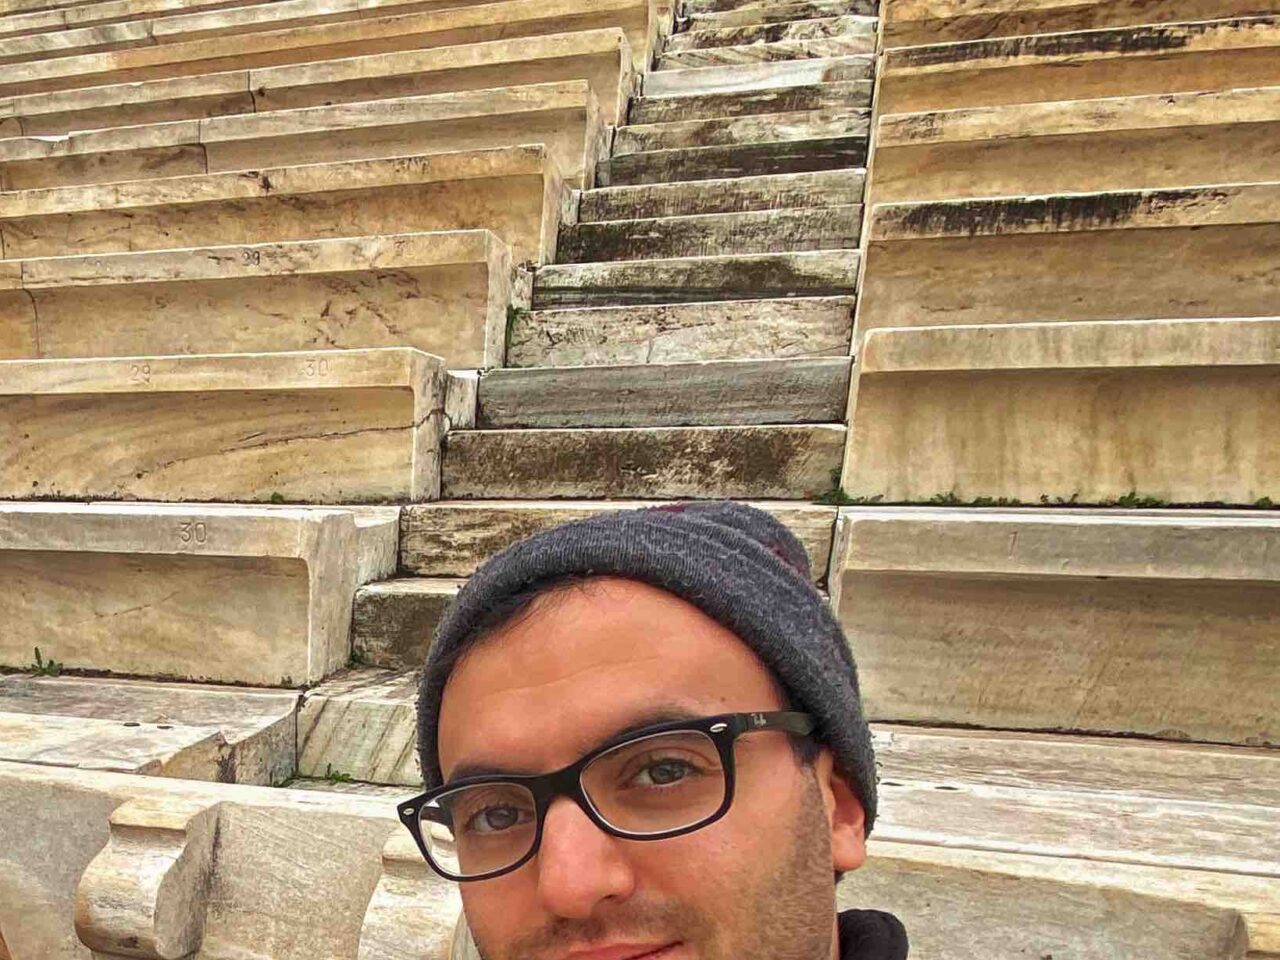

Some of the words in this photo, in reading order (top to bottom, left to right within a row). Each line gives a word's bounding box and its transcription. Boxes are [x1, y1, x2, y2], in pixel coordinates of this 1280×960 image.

[131, 364, 152, 384] 29
[303, 358, 329, 377] 30
[179, 521, 207, 543] 30
